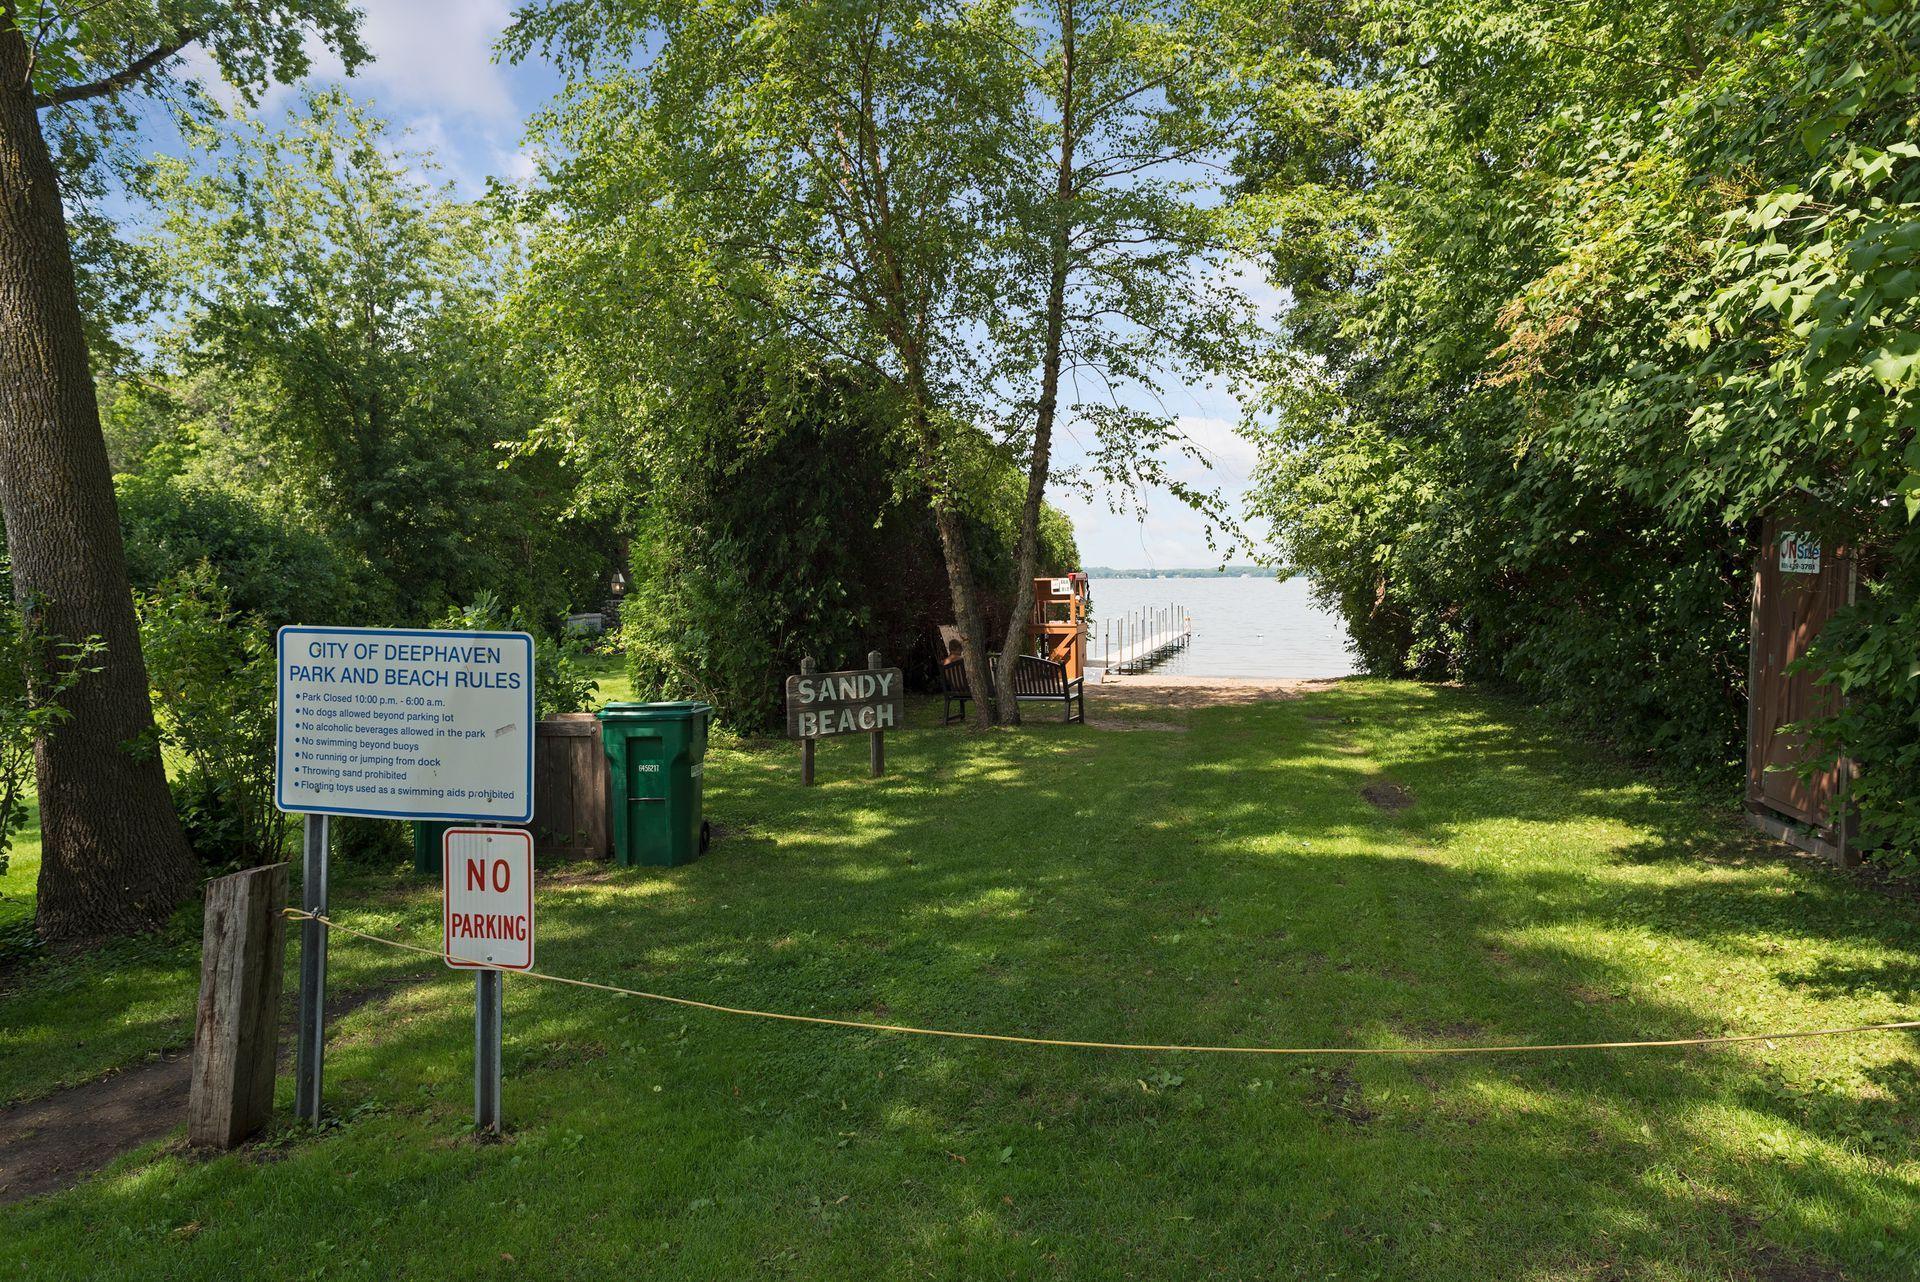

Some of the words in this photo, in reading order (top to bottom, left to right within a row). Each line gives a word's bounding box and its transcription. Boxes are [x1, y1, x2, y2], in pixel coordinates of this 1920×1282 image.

[309, 642, 348, 658] CITY
[354, 643, 379, 660] OF
[385, 645, 500, 664] DEEPHAVEN
[290, 666, 336, 683] PARK
[340, 667, 379, 684] AND
[385, 669, 448, 687] BEACH
[455, 671, 520, 689] RULES
[798, 673, 893, 704] SANDY
[302, 692, 321, 701] Park
[323, 693, 352, 703] Closed
[355, 694, 378, 704] 10:00
[380, 697, 398, 706] p.m.
[405, 696, 424, 706] 6:00
[426, 699, 446, 707] a.m.
[302, 707, 314, 716] No
[316, 707, 337, 718] dogs
[339, 708, 371, 719] allowed
[373, 710, 405, 721] beyond
[407, 713, 440, 723] parking
[442, 713, 454, 722] lot
[798, 704, 894, 737] BEACH
[302, 722, 314, 731] No
[316, 722, 353, 733] alcoholic
[355, 724, 399, 736] beverages
[400, 726, 434, 737] allowed
[436, 728, 445, 737] in
[447, 728, 463, 738] the
[465, 729, 486, 739] park
[301, 736, 314, 746] No
[316, 738, 358, 750] swimming
[360, 739, 391, 750] beyond
[393, 742, 419, 752] buoys
[301, 751, 314, 760] No
[316, 753, 347, 764] running
[359, 754, 394, 766] jumping
[396, 756, 416, 765] from
[418, 758, 441, 767] dock
[302, 766, 340, 778] Throwing
[342, 769, 363, 777] sand
[364, 771, 407, 780] prohibited
[301, 781, 334, 792] Floating
[336, 783, 354, 793] toys
[356, 785, 376, 793] used
[391, 787, 396, 795] a
[398, 786, 444, 798] swimming
[446, 788, 466, 797] aids
[468, 789, 514, 799] prohibited
[467, 858, 510, 893] NO
[451, 913, 526, 941] PARKING
